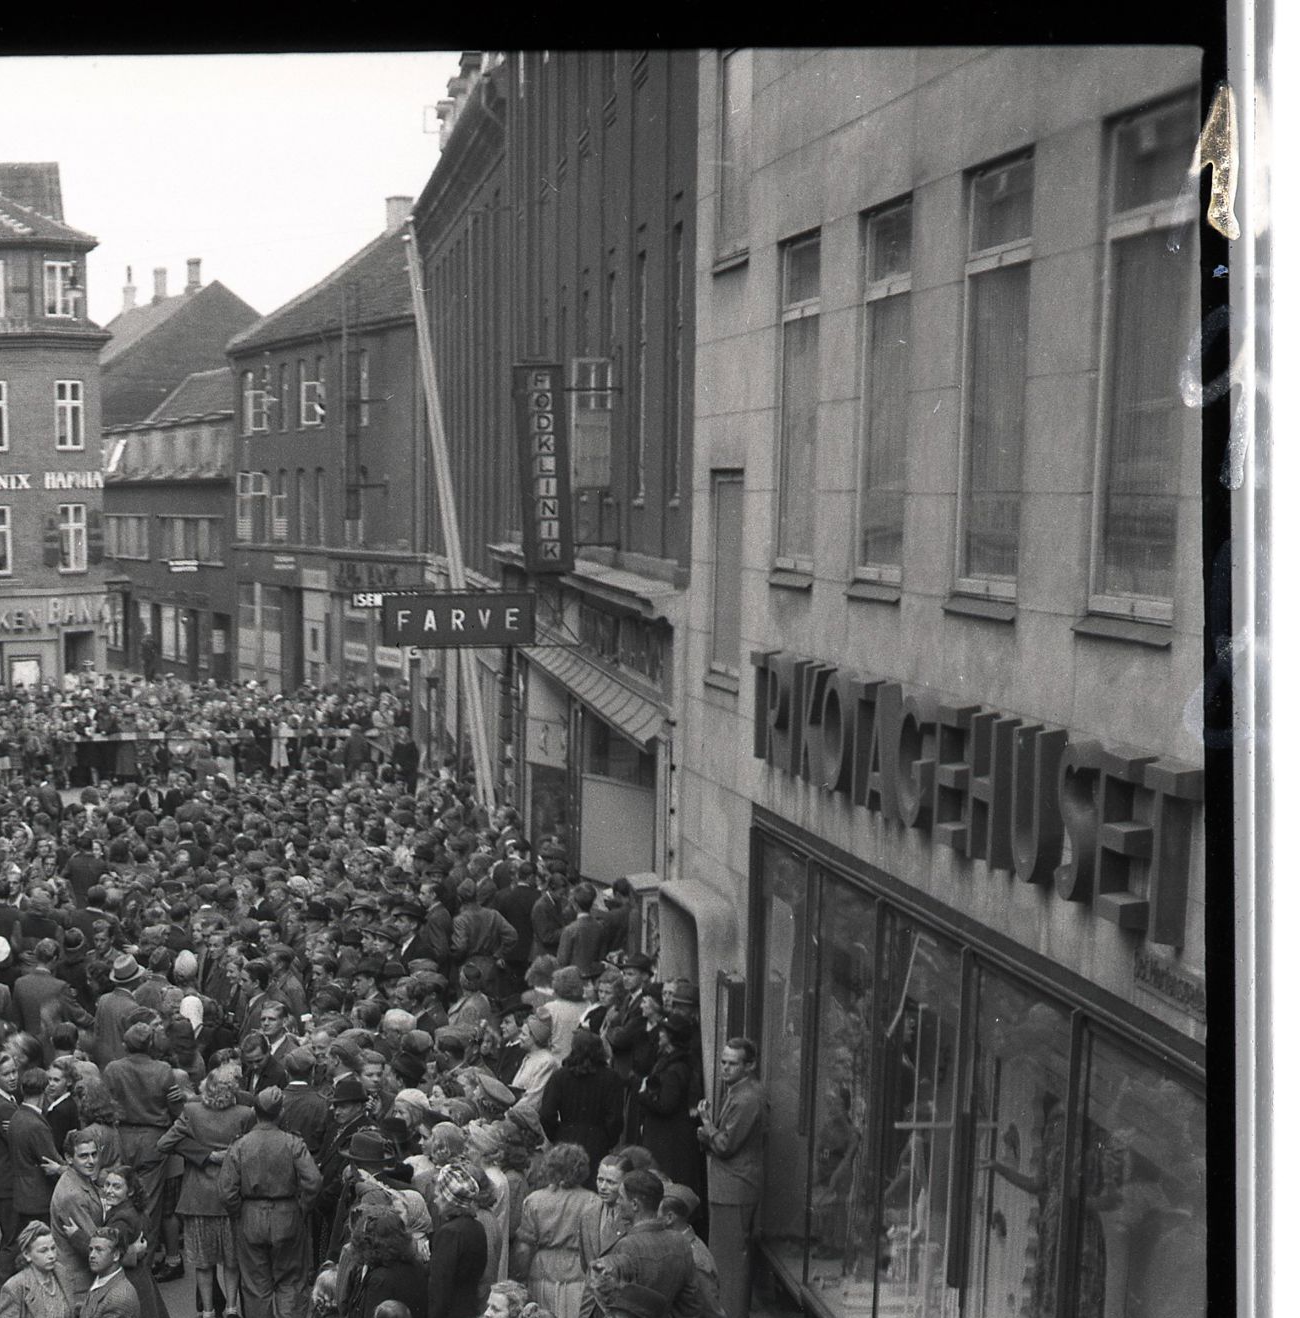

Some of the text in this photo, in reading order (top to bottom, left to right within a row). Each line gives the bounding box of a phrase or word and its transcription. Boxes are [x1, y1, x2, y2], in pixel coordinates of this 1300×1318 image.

[533, 371, 560, 560] FODKLINIK
[43, 470, 104, 489] HAFNIA
[397, 607, 521, 632] FARVE
